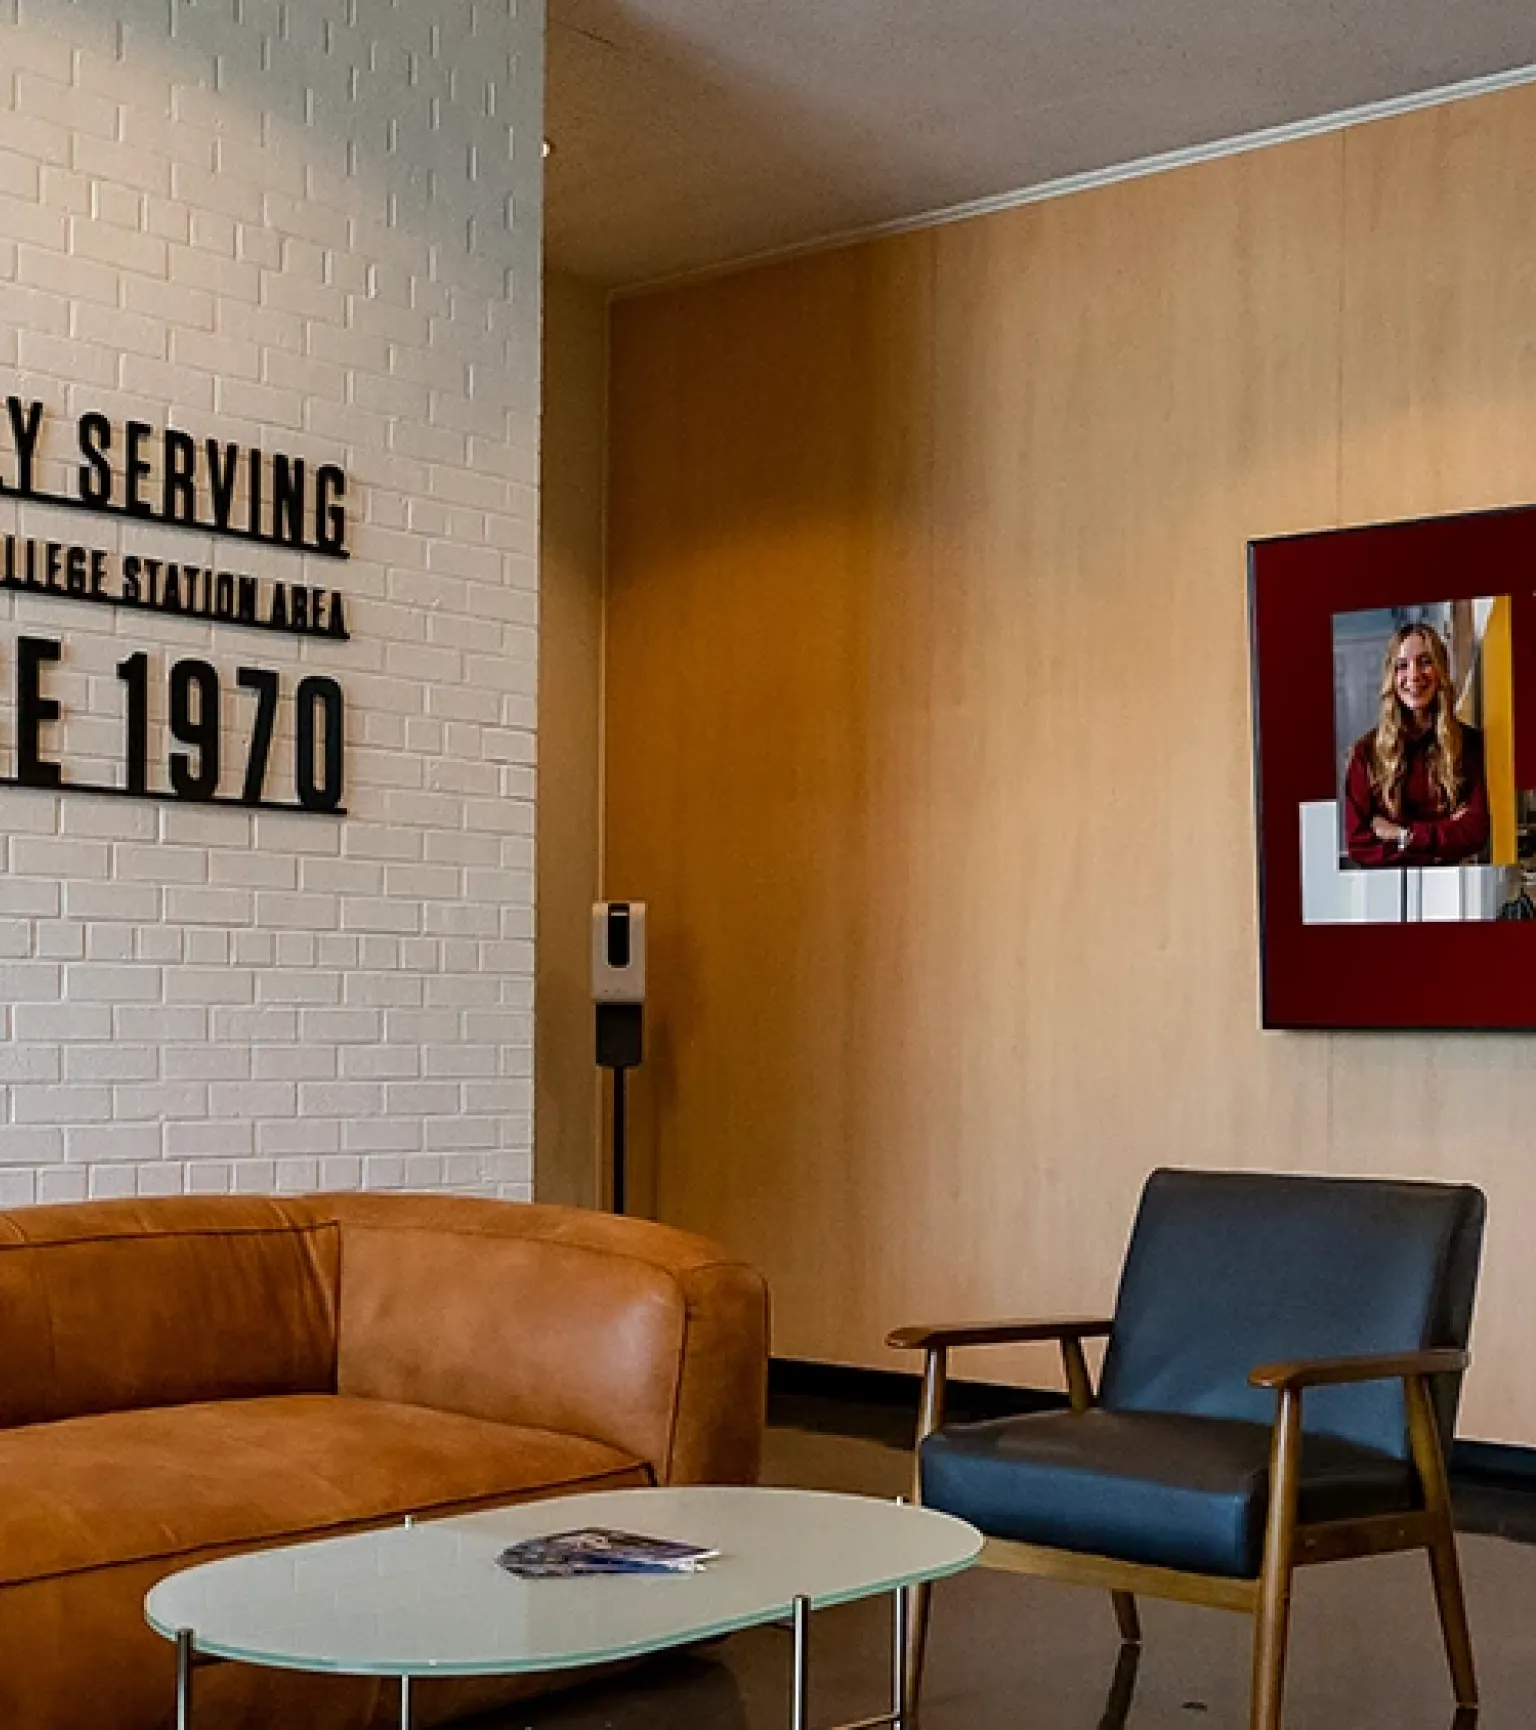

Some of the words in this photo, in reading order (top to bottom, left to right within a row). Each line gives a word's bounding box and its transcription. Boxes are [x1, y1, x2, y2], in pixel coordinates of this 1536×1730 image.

[0, 395, 43, 496] Y
[78, 411, 346, 549] SERVING
[123, 555, 258, 622] STATION
[271, 583, 346, 634] AREA
[116, 652, 343, 810] 1970
